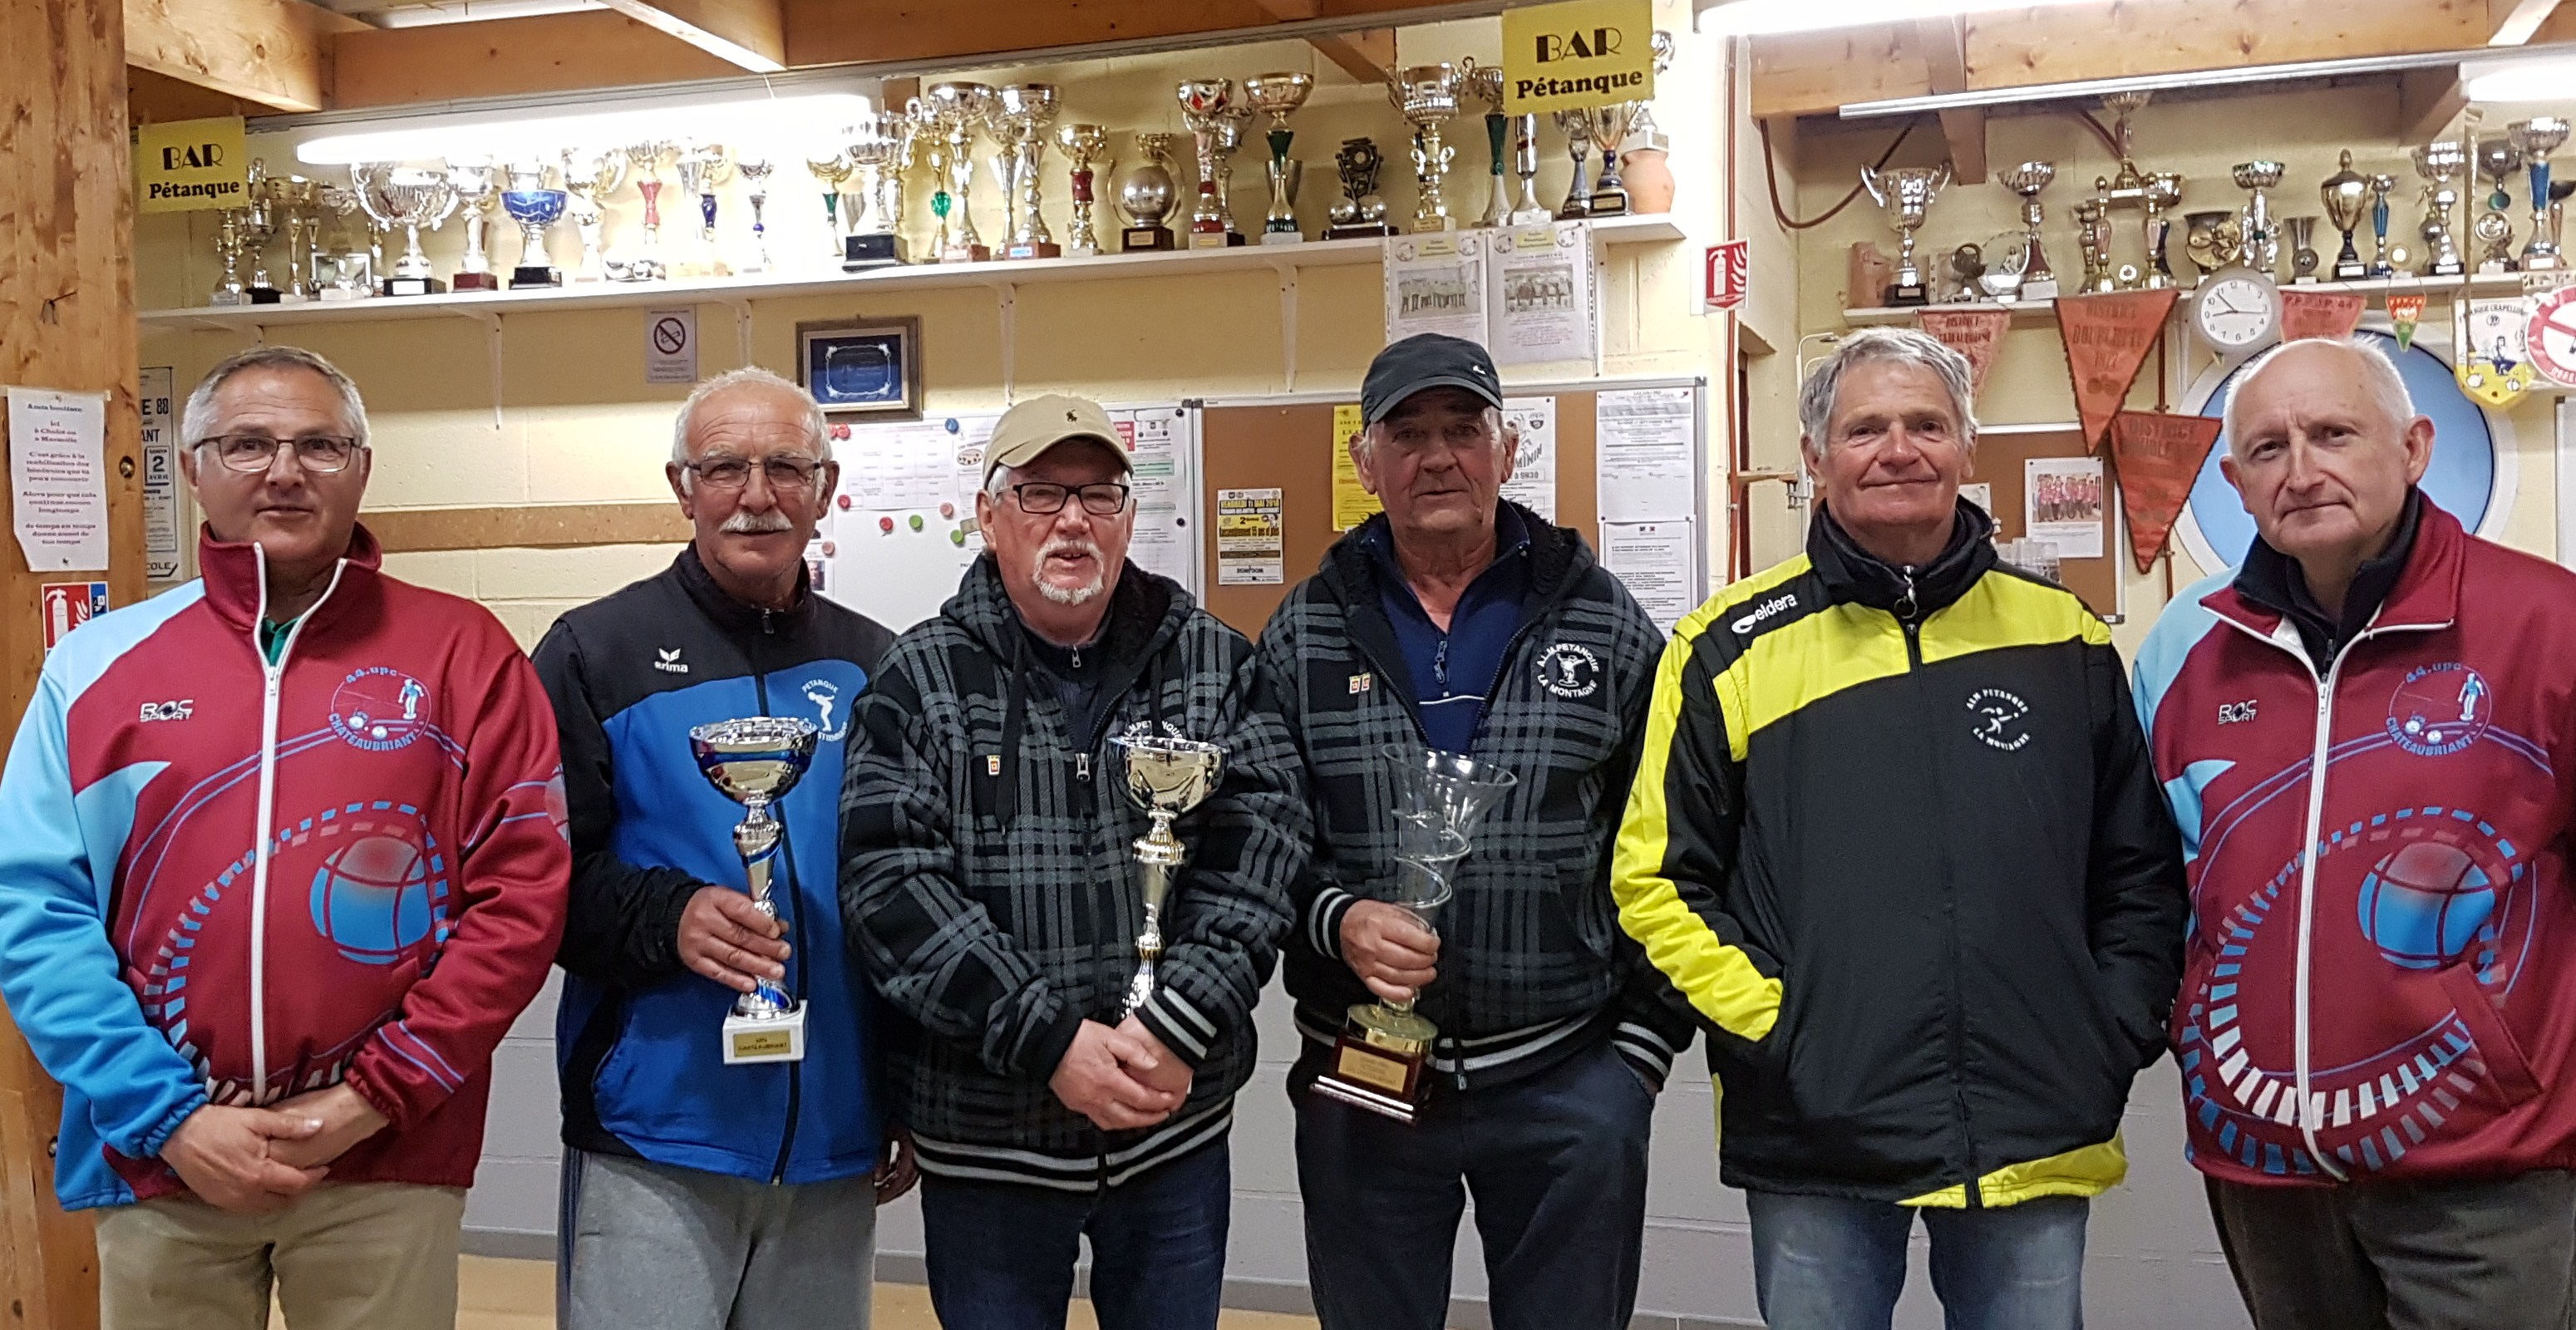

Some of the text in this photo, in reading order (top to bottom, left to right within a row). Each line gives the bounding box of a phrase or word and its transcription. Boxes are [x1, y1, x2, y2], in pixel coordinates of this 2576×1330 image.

[1536, 27, 1623, 63] BAR
[1515, 71, 1643, 99] Pétanque
[163, 143, 224, 170] BAR
[149, 181, 240, 199] Pétanque
[152, 455, 165, 472] 2
[1755, 594, 1798, 620] eldera
[654, 661, 688, 673] erima
[801, 678, 839, 693] PETANQUE
[1537, 674, 1598, 698] LA MONTAGNE
